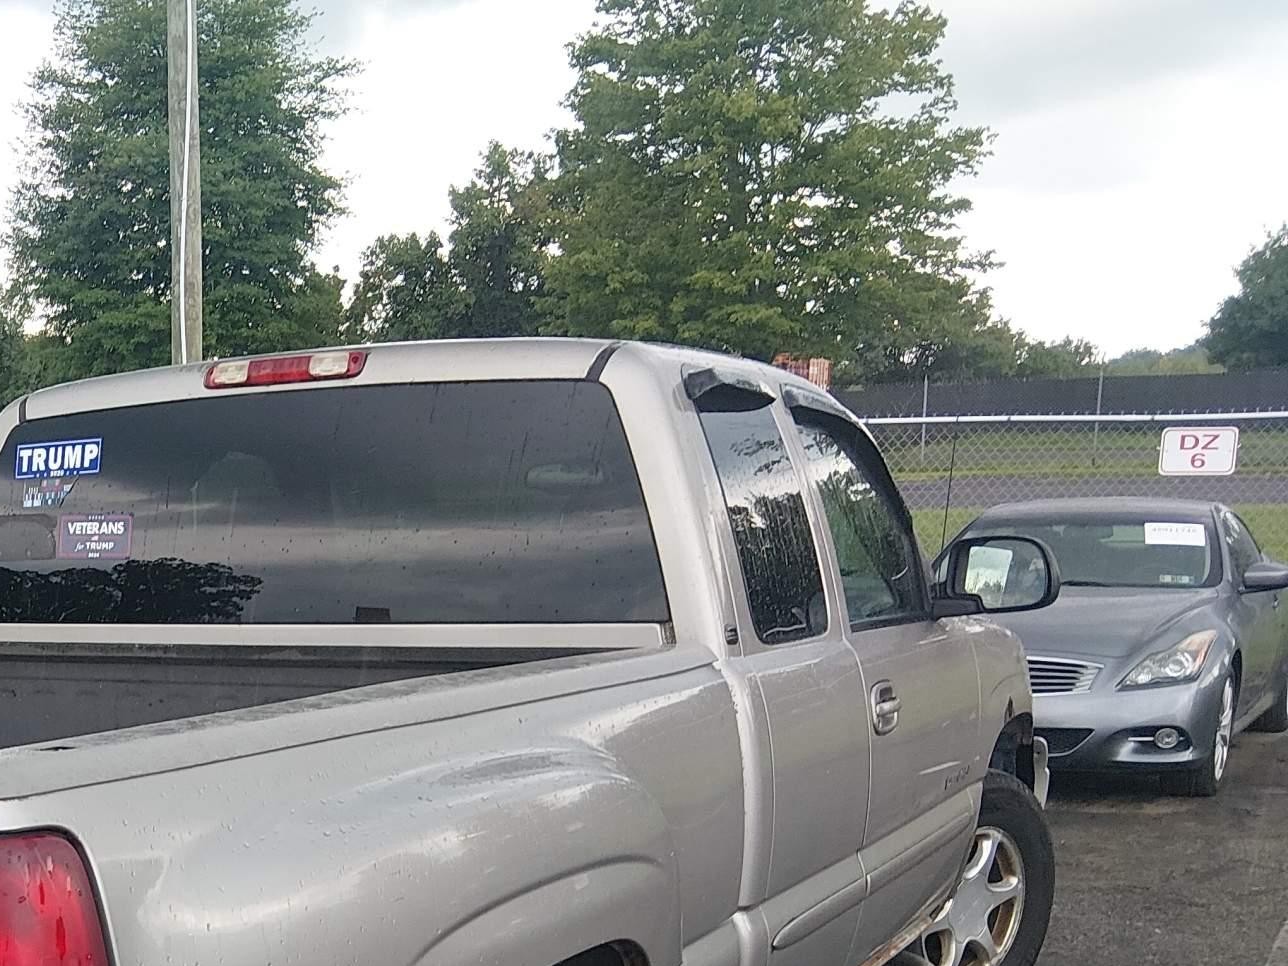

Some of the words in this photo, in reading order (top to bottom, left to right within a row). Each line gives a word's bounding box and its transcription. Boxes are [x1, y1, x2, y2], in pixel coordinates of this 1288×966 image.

[1179, 434, 1220, 450] DZ
[19, 443, 99, 473] TRUMP
[1190, 453, 1207, 469] 6
[67, 521, 125, 535] VETERANS
[74, 542, 85, 552] for
[86, 541, 115, 550] TRUMP
